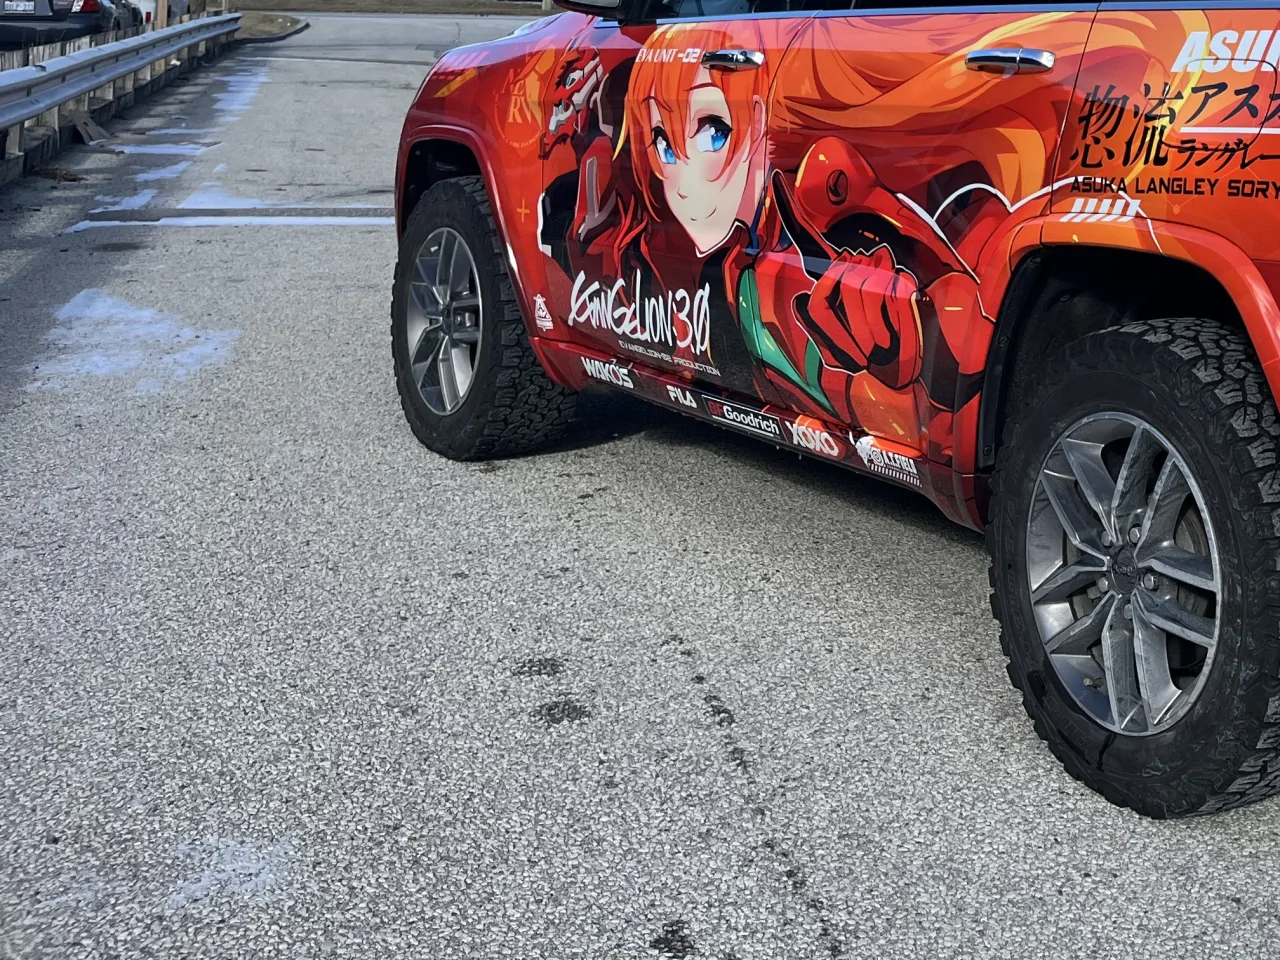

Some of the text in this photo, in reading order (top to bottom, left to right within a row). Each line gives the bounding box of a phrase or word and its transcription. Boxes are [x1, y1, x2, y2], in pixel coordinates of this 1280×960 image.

[636, 48, 655, 63] EVA
[654, 48, 678, 63] UNIT
[1069, 175, 1128, 194] ASUKA
[1135, 176, 1220, 196] LANGLEY
[672, 356, 722, 377] PRODUCTION
[666, 385, 698, 409] FILA
[708, 400, 780, 435] BFGoodrich
[785, 420, 839, 457] XOXO
